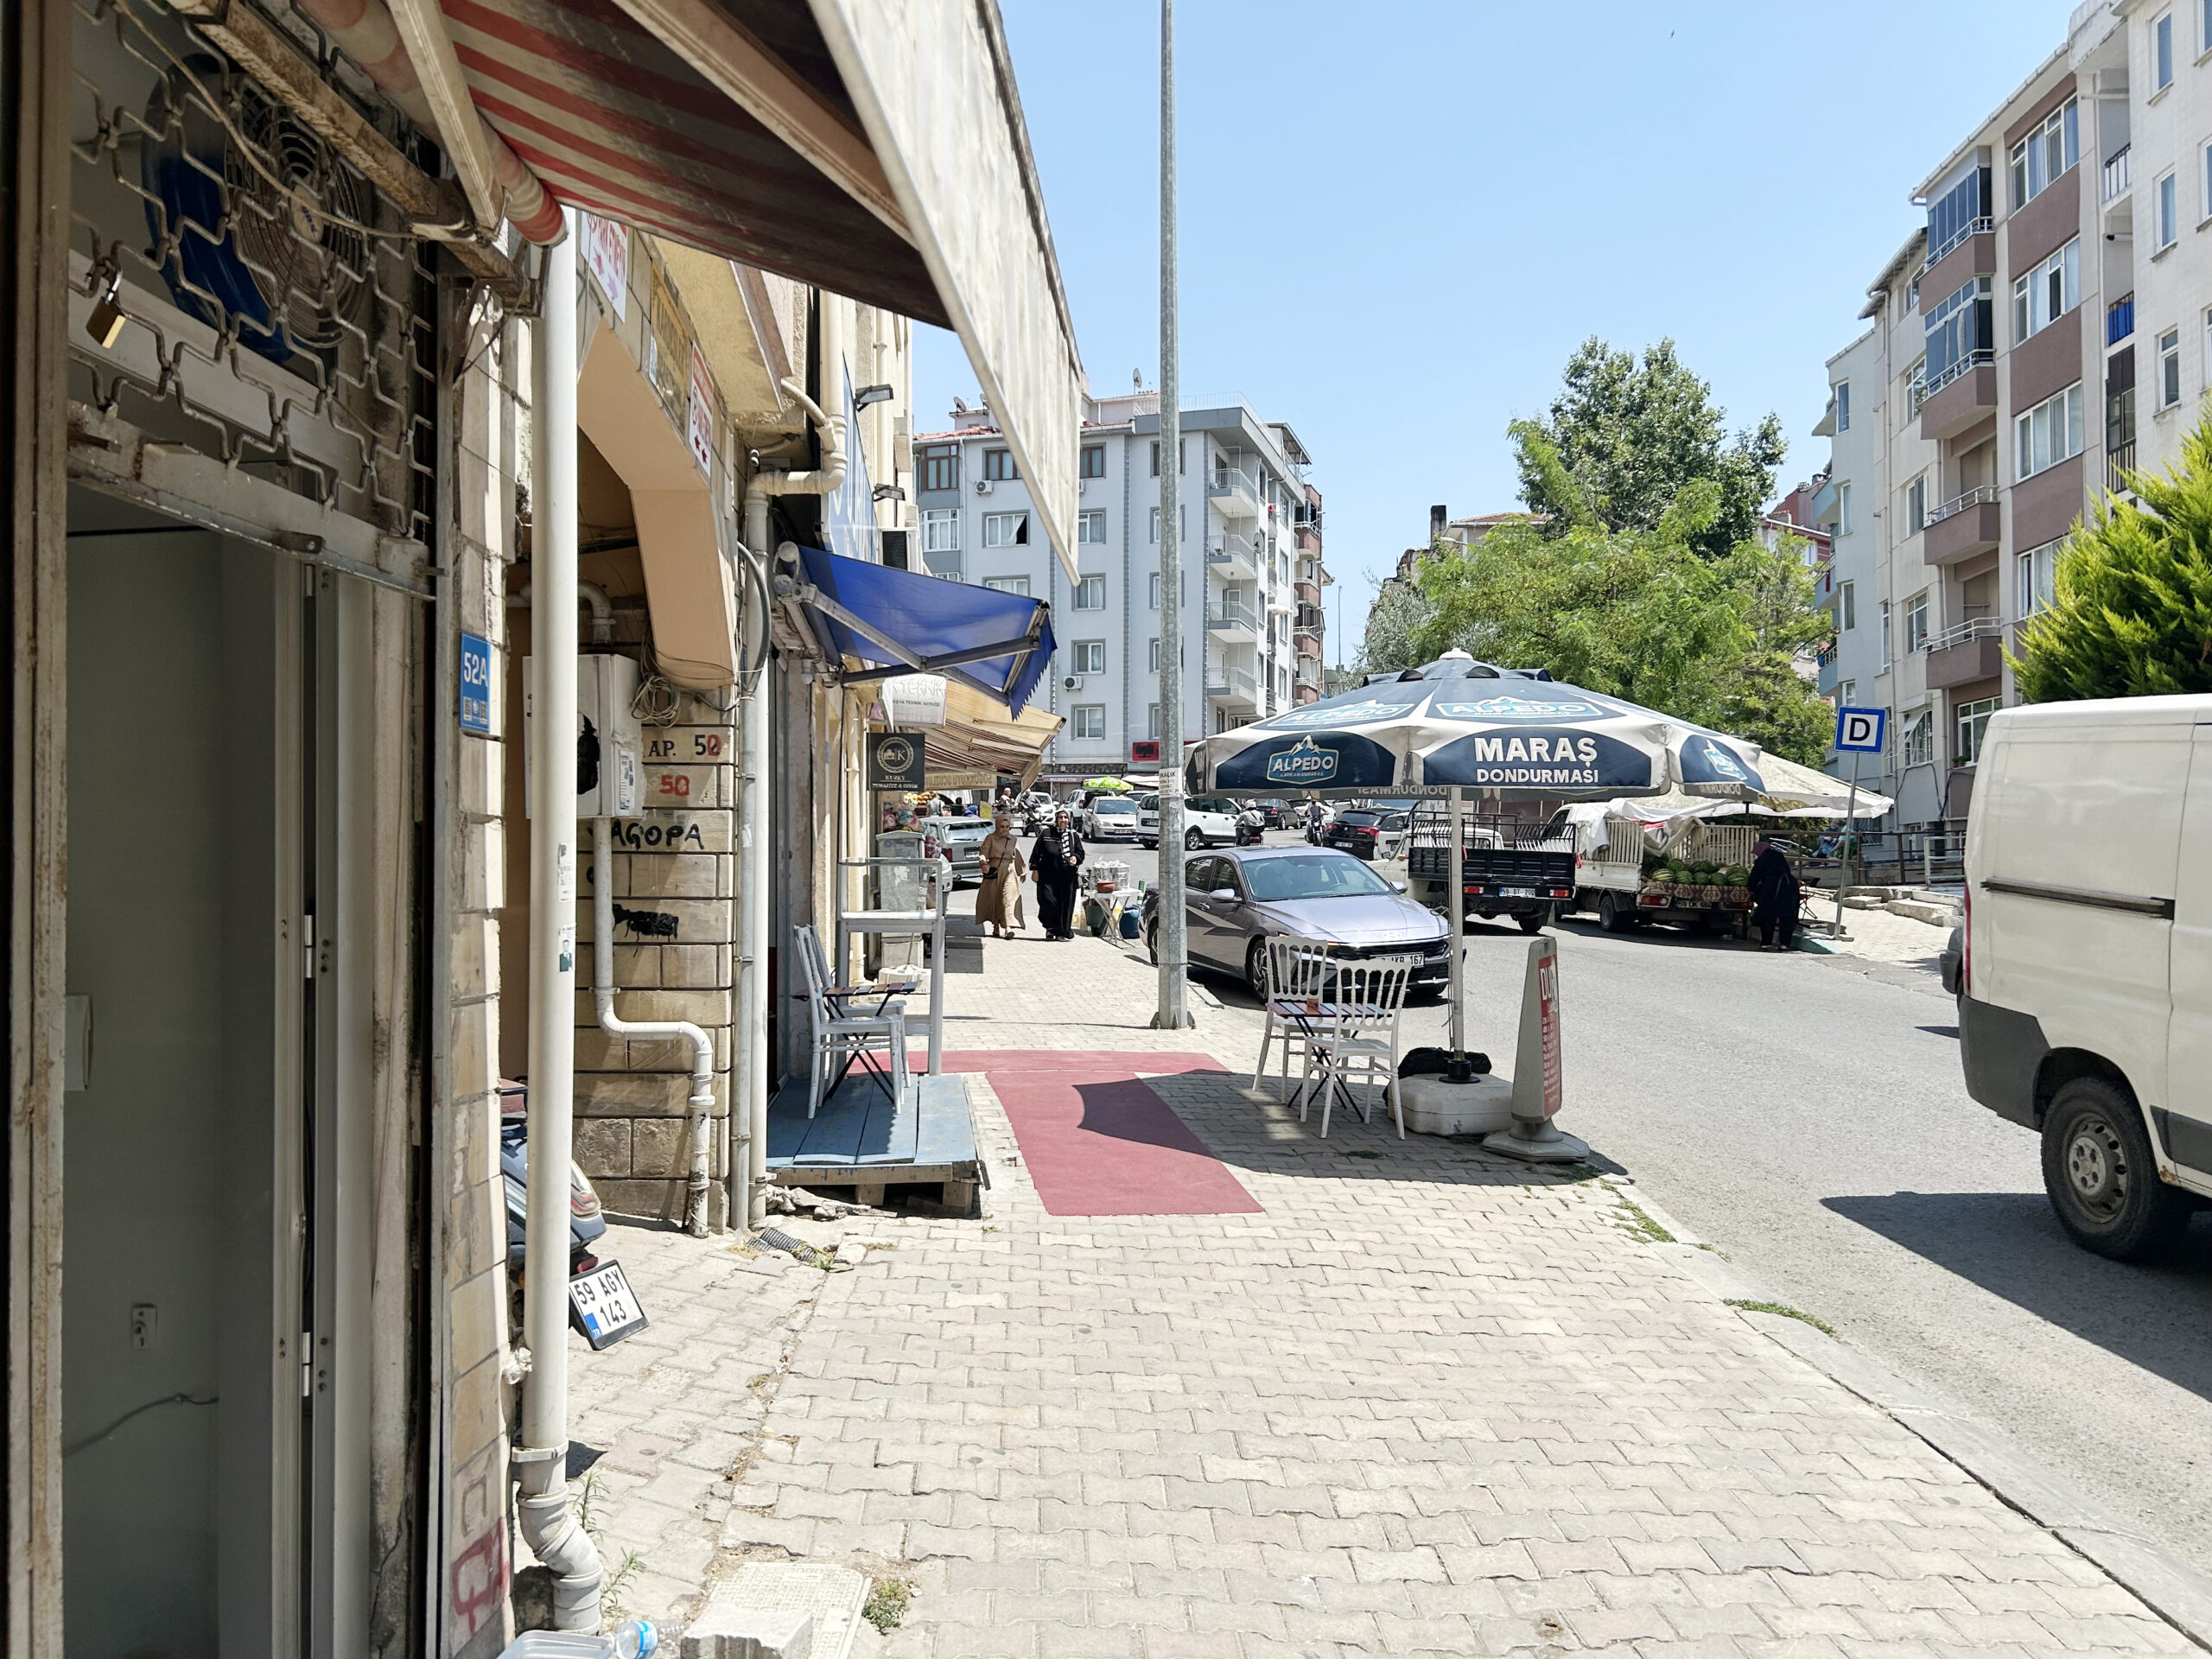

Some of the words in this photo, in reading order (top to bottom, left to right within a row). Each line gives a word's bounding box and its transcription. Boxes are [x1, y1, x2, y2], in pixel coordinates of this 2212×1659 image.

[464, 652, 488, 688] 52A
[1292, 707, 1400, 721] ALPEDO
[1452, 704, 1586, 713] ALPEDO
[1849, 717, 1871, 741] D
[649, 740, 677, 757] AP.
[1474, 737, 1598, 768] MARAŞ
[1272, 755, 1334, 772] ALPEDO
[659, 774, 690, 797] 50
[1477, 768, 1599, 784] DONDURMASI
[1410, 955, 1423, 965] 167
[574, 1281, 596, 1305] 59
[598, 1269, 625, 1297] AGY
[600, 1300, 626, 1327] 143
